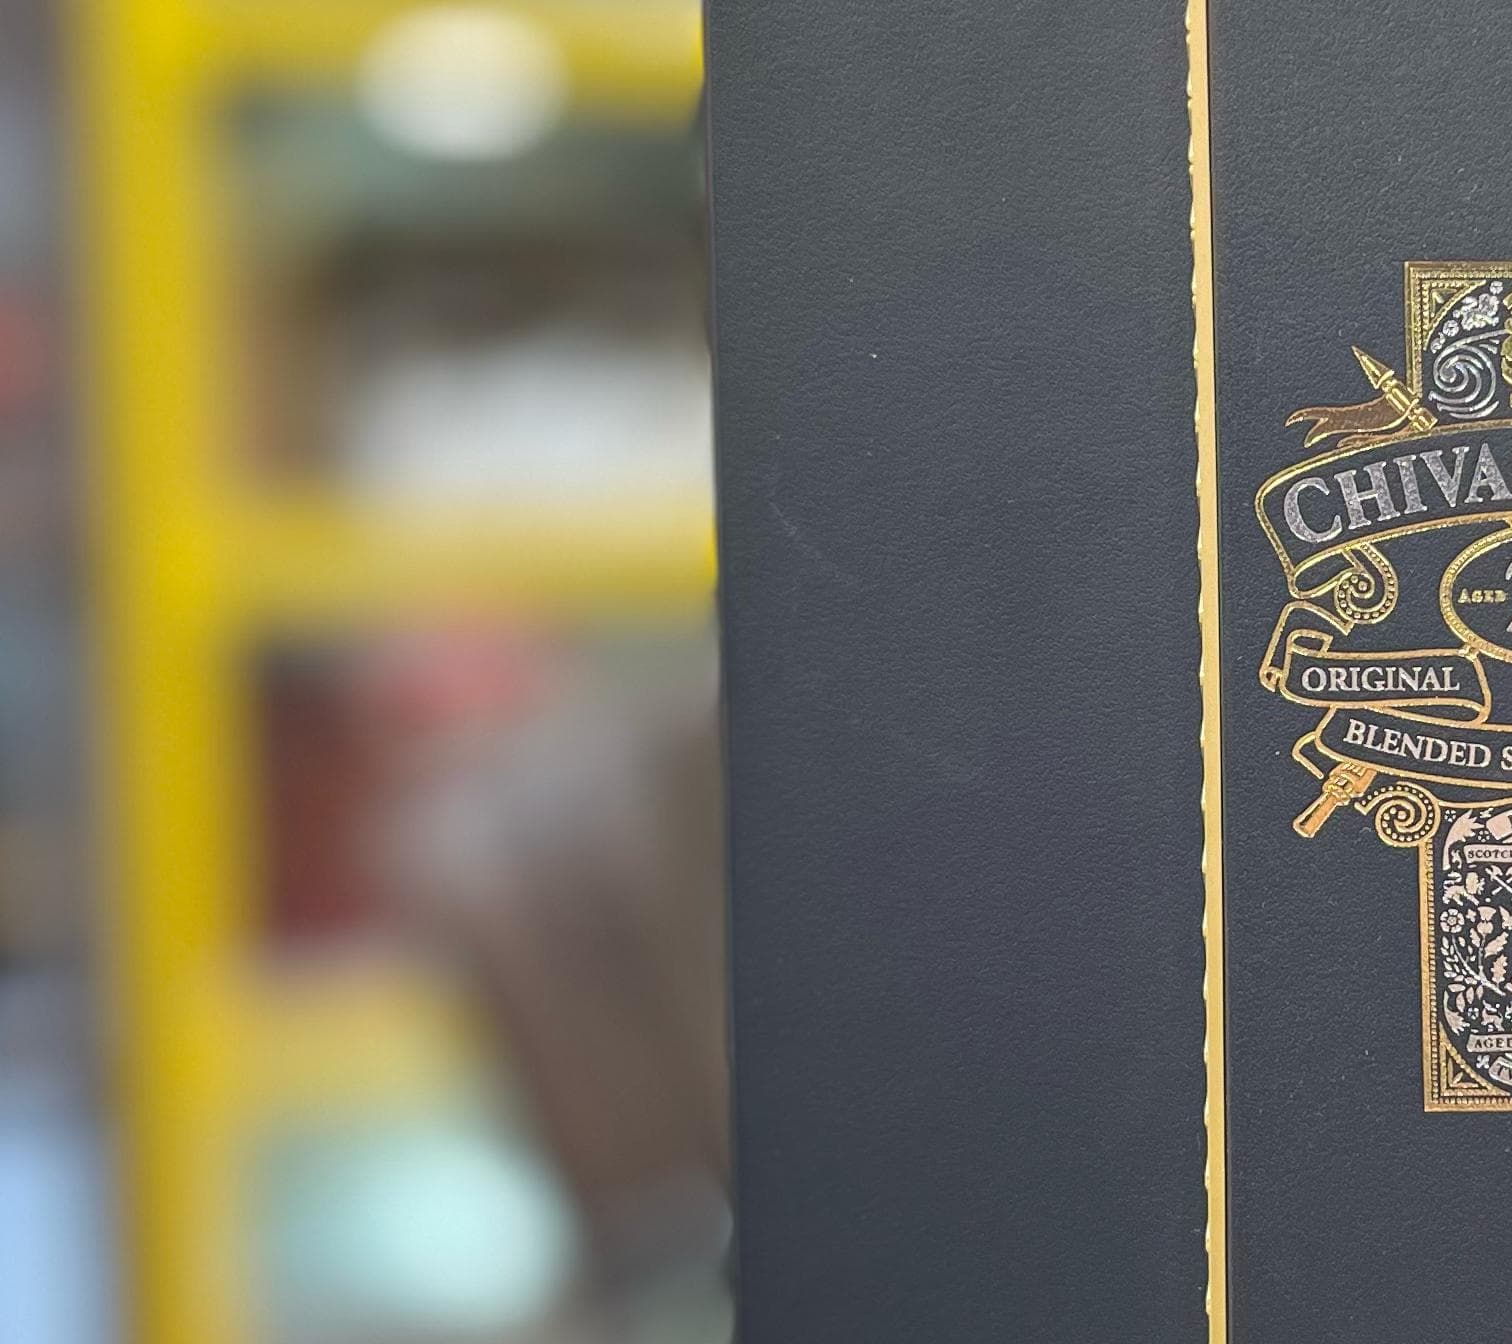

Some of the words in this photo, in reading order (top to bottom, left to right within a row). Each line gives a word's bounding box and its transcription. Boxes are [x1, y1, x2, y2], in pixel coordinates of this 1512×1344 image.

[1458, 588, 1506, 604] AGED
[1301, 667, 1460, 692] ORIGINAL
[1343, 719, 1491, 768] BLENDED
